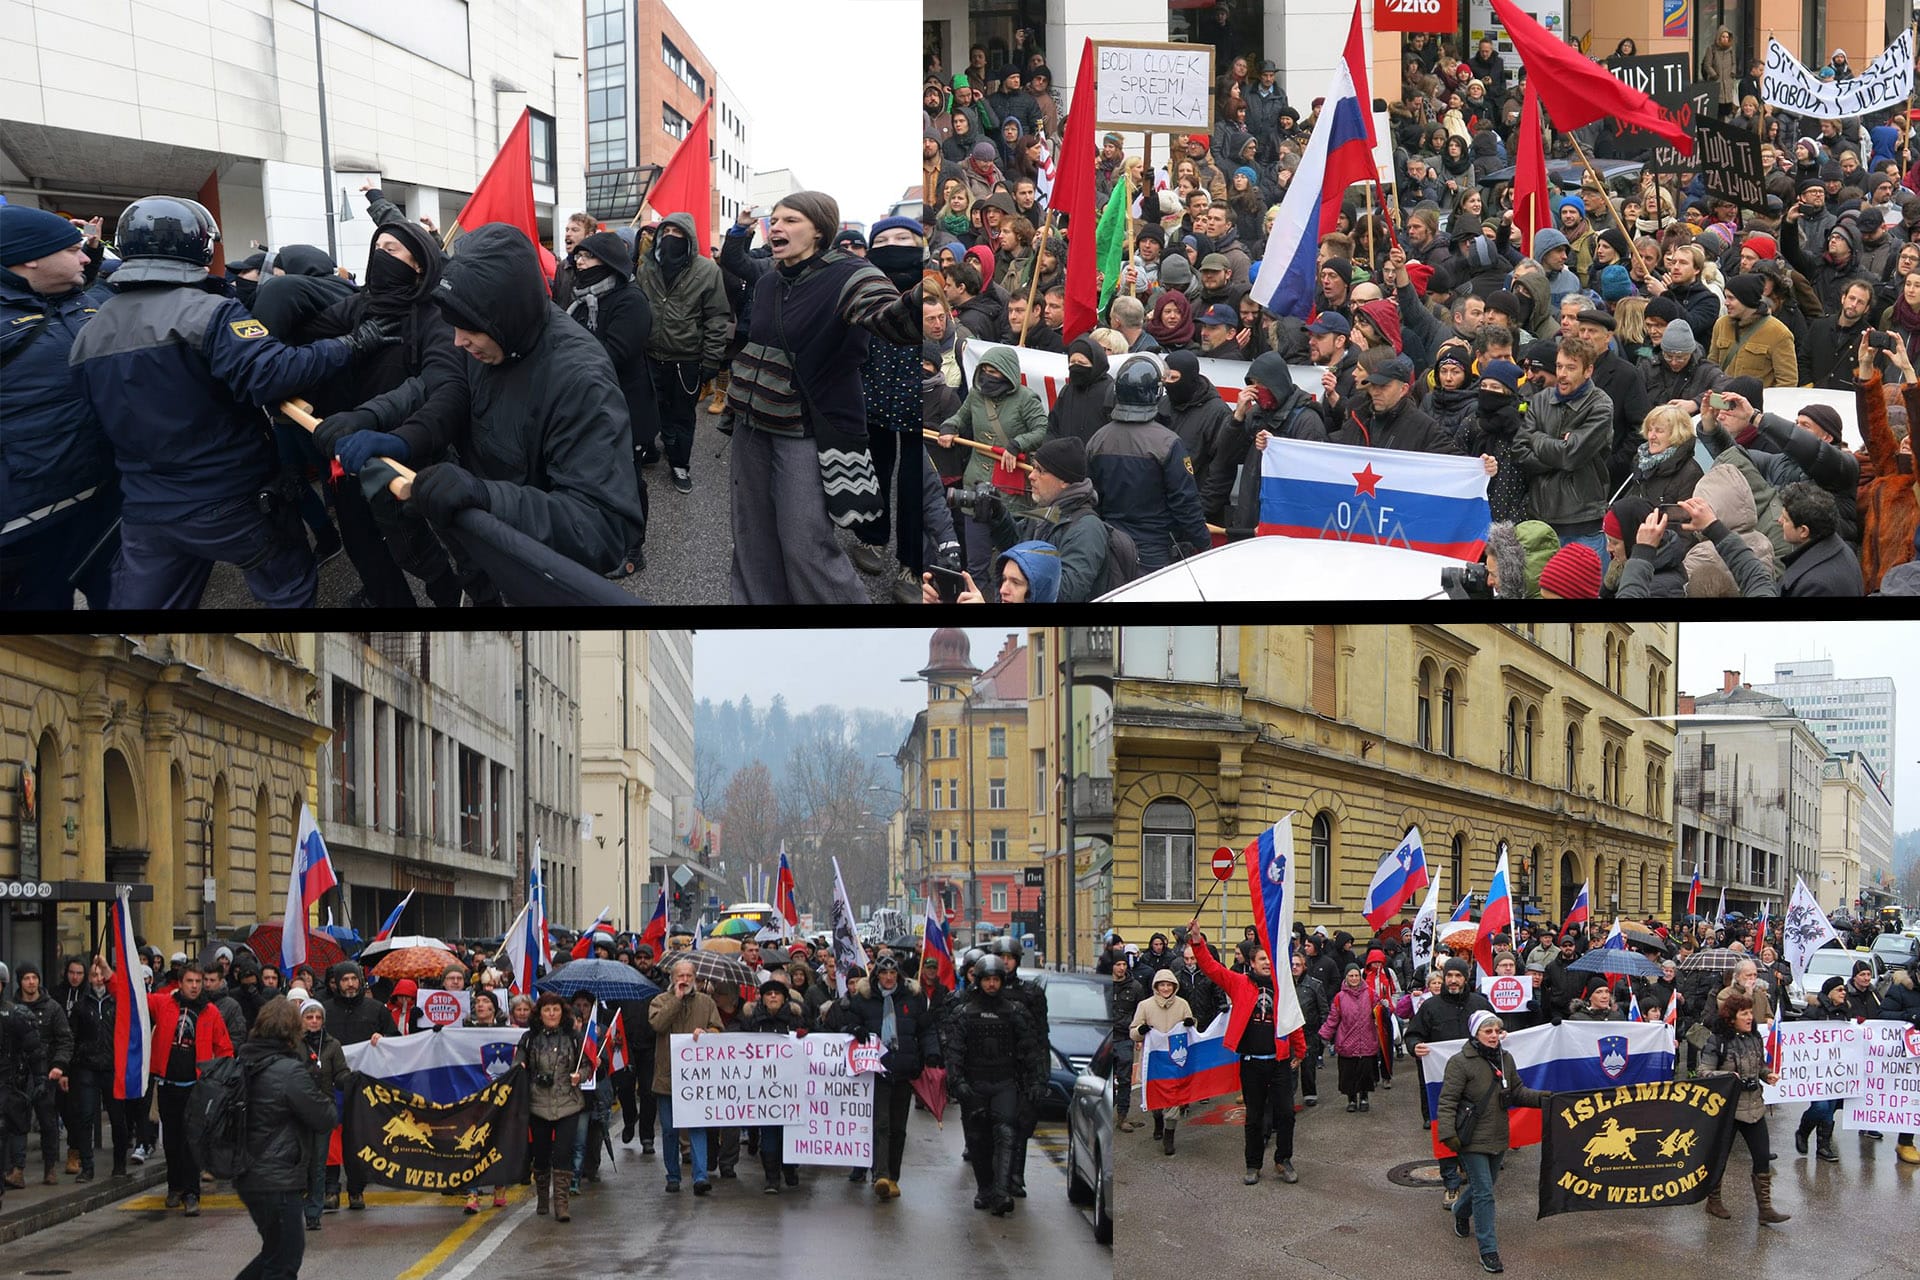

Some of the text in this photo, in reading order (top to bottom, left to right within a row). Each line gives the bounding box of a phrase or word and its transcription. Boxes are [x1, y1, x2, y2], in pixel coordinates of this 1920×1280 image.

[1101, 51, 1201, 75] BODI ČLOVEK
[1120, 75, 1184, 94] SPREJMI
[1762, 69, 1907, 116] SVOBODA LJUDEM
[1108, 94, 1202, 120] ČLOVEKA
[1705, 169, 1724, 193] ZA
[11, 885, 20, 894] 13
[40, 885, 50, 895] 20
[1498, 981, 1517, 990] STOP
[432, 995, 453, 1004] STOP
[432, 1013, 455, 1021] ISLAM
[1763, 1029, 1855, 1046] RAR-ŠEFIC
[681, 1043, 793, 1062] CERAR-ŠEFIC
[1793, 1049, 1820, 1062] NAJ
[1829, 1047, 1841, 1059] MI
[1869, 1045, 1884, 1057] NO
[681, 1064, 777, 1081] KAM NAJ MI
[810, 1062, 826, 1076] NO
[1781, 1063, 1858, 1082] EMO, LAČNI
[825, 1082, 869, 1097] MONEY
[1780, 1080, 1860, 1098] SLOVENCI?!
[1867, 1078, 1884, 1090] NO
[681, 1082, 798, 1104] GREMO, LAČNI
[1866, 1094, 1908, 1107] STOP
[705, 1104, 800, 1121] SLOVENCI?!
[810, 1101, 871, 1118] NO FOOD
[1561, 1081, 1727, 1130] ISLAMISTS
[1853, 1110, 1920, 1127] IMIGRANTS
[809, 1120, 857, 1136] STOP
[795, 1139, 871, 1158] IMIGRANTS
[357, 1145, 502, 1188] NOT WELCOME
[1557, 1164, 1709, 1203] NOT WELCOME
